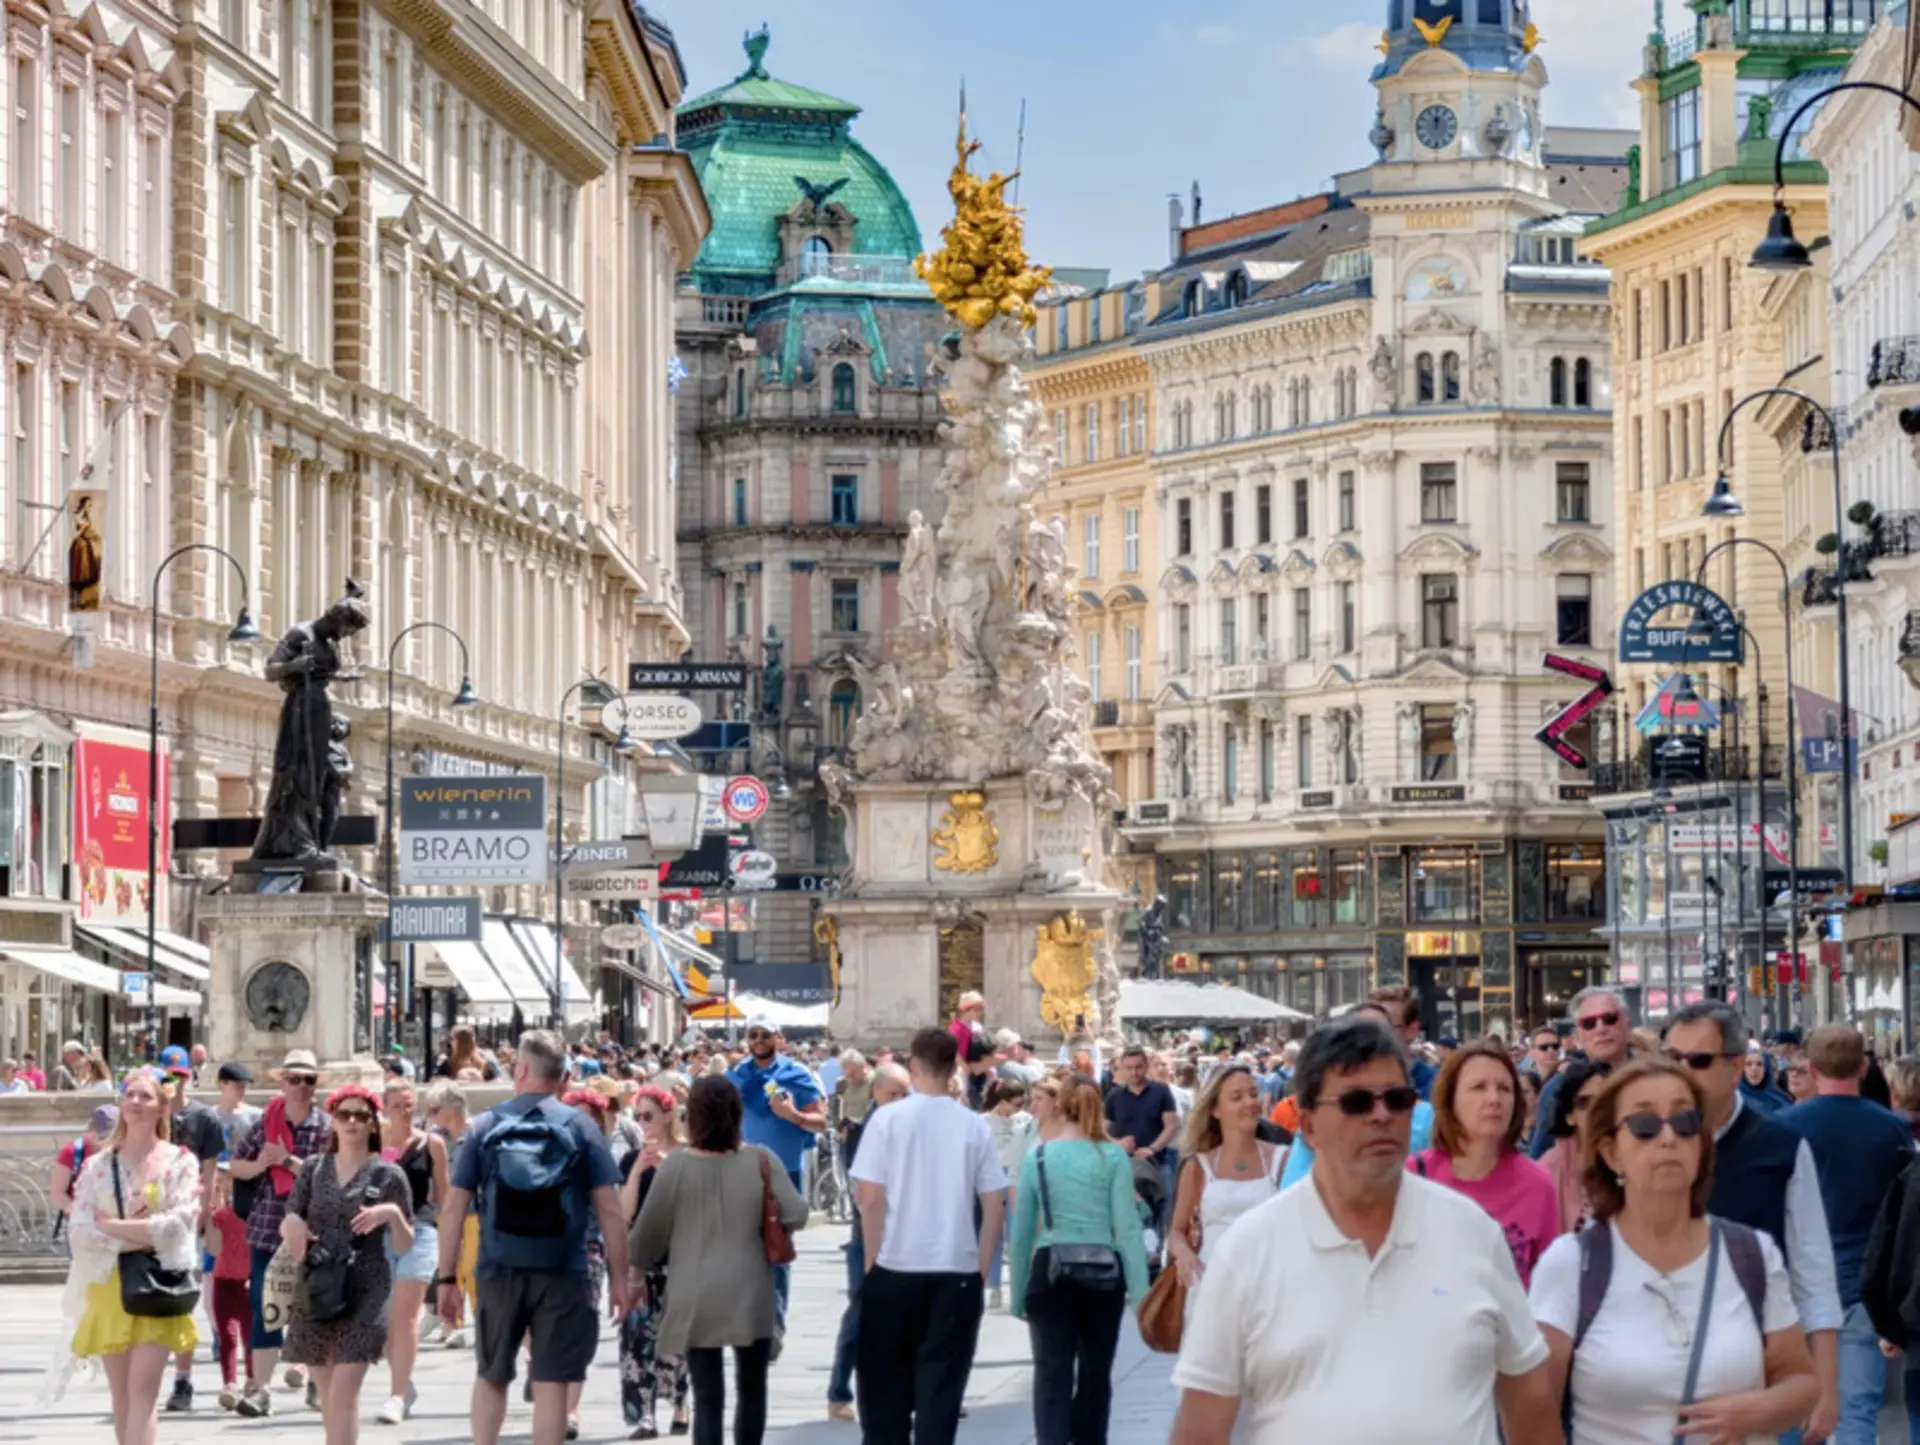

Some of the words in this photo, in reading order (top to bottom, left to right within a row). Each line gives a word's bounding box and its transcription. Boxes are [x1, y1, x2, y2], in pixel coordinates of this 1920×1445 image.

[634, 670, 690, 684] GIORGIO
[692, 670, 741, 685] ARMANI
[413, 787, 532, 803] wienerin
[411, 836, 531, 861] BRAMO
[567, 876, 634, 892] swatch
